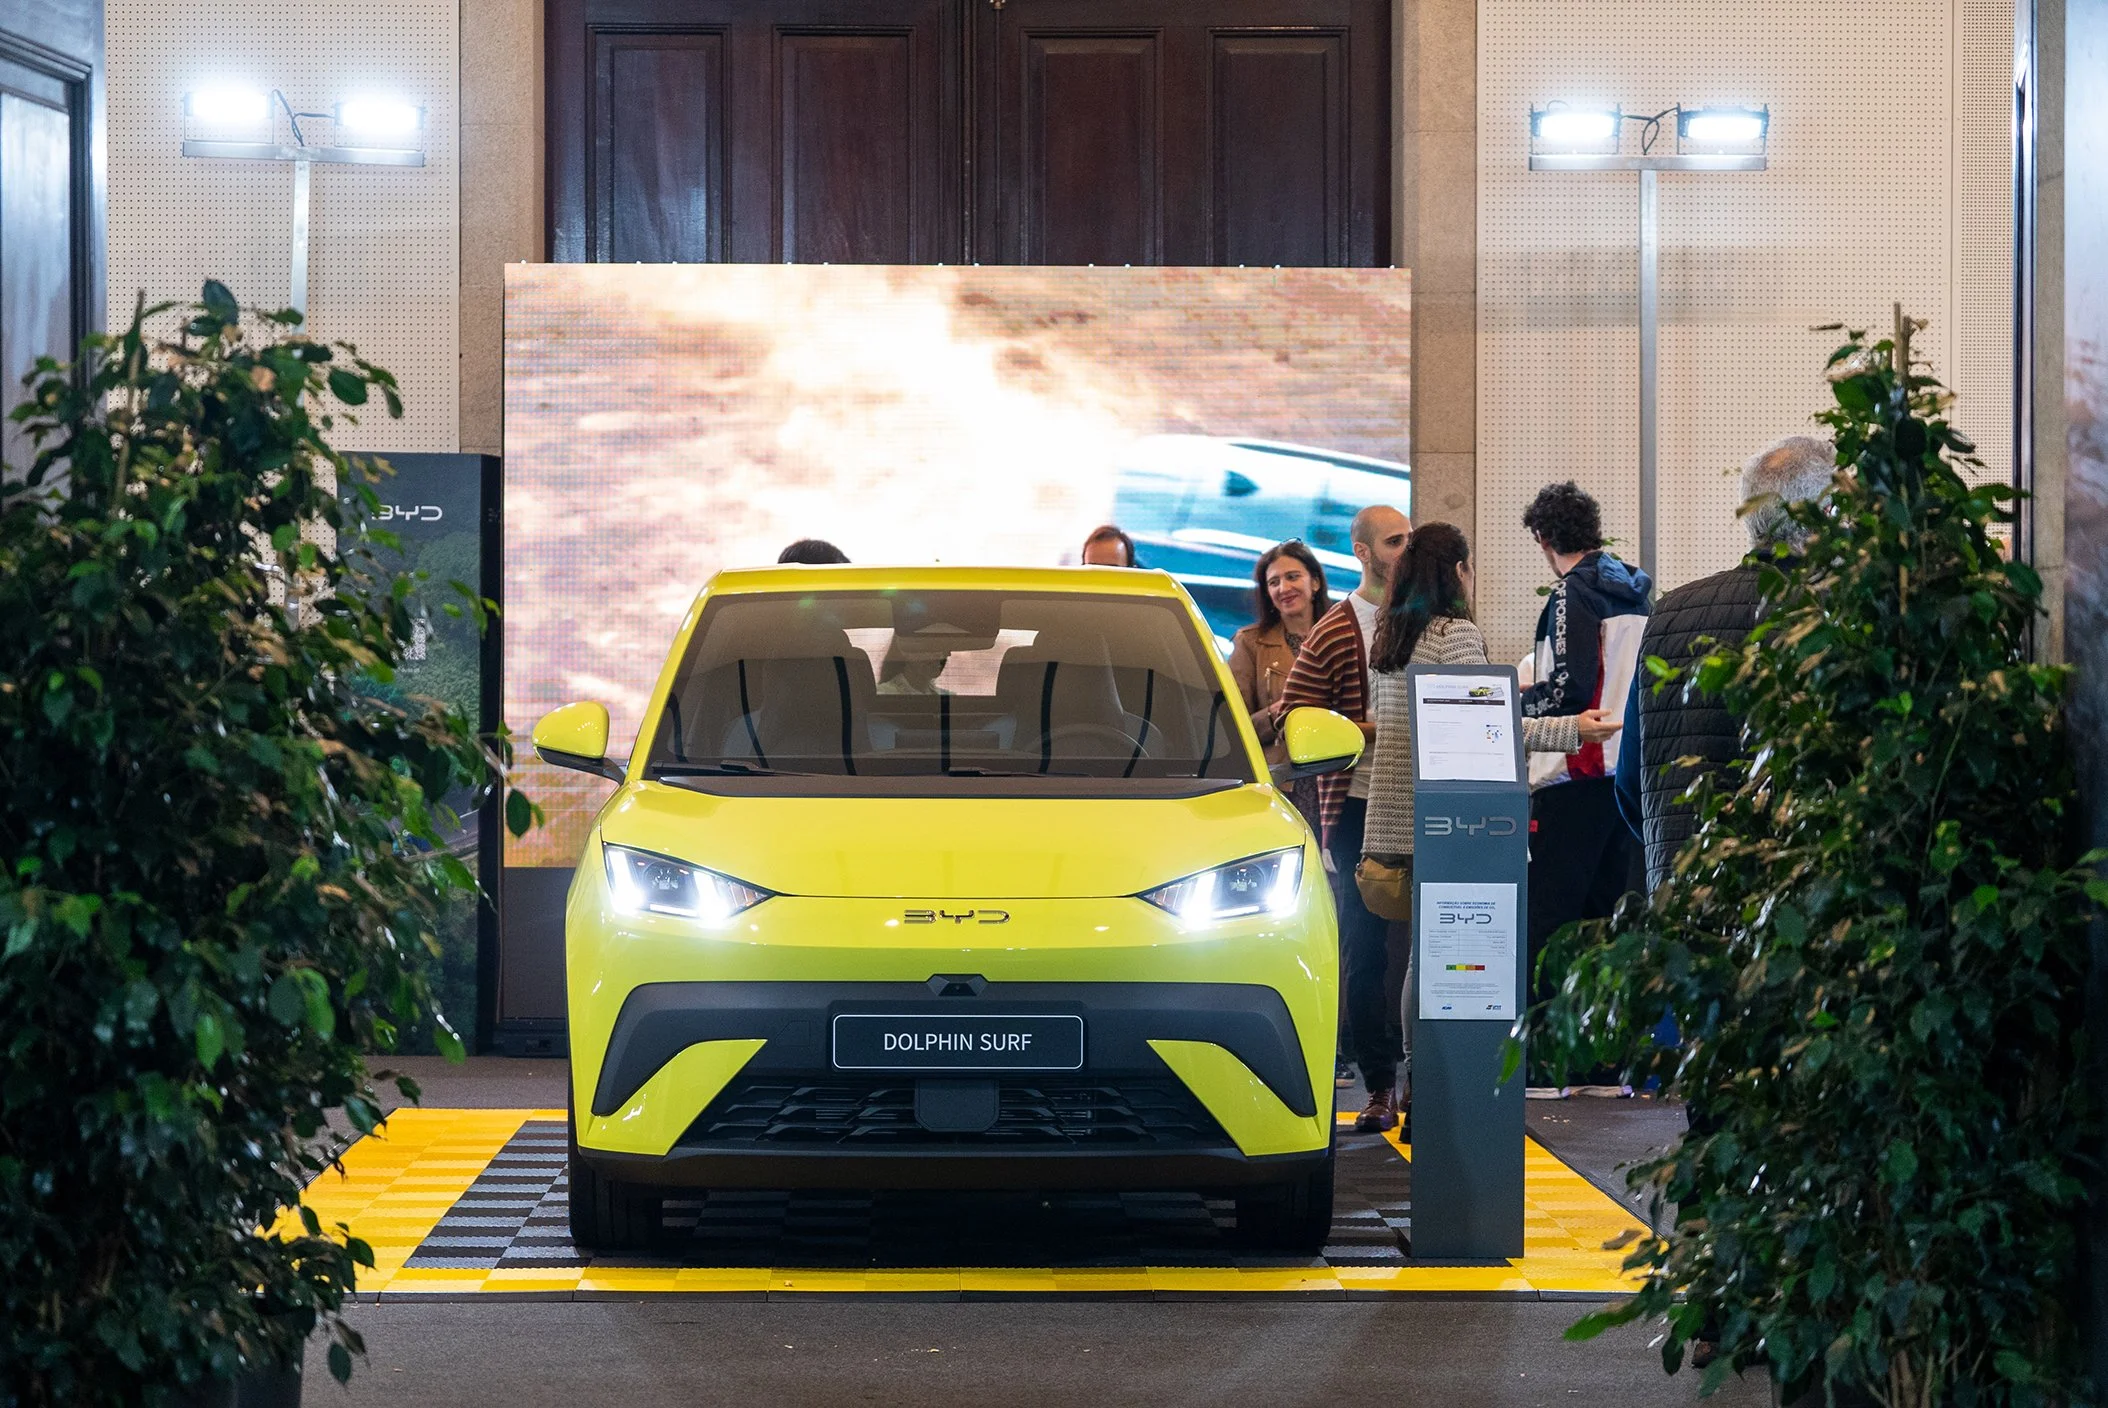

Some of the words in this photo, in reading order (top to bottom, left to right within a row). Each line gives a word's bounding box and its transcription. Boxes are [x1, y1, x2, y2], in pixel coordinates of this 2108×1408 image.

[371, 504, 443, 521] BYD
[1555, 599, 1567, 656] PORCHES
[1424, 816, 1517, 837] BYD
[903, 909, 1012, 925] BYD
[1439, 913, 1492, 924] BYD
[883, 1033, 973, 1051] DOLPHIN
[980, 1032, 1032, 1051] SURF
